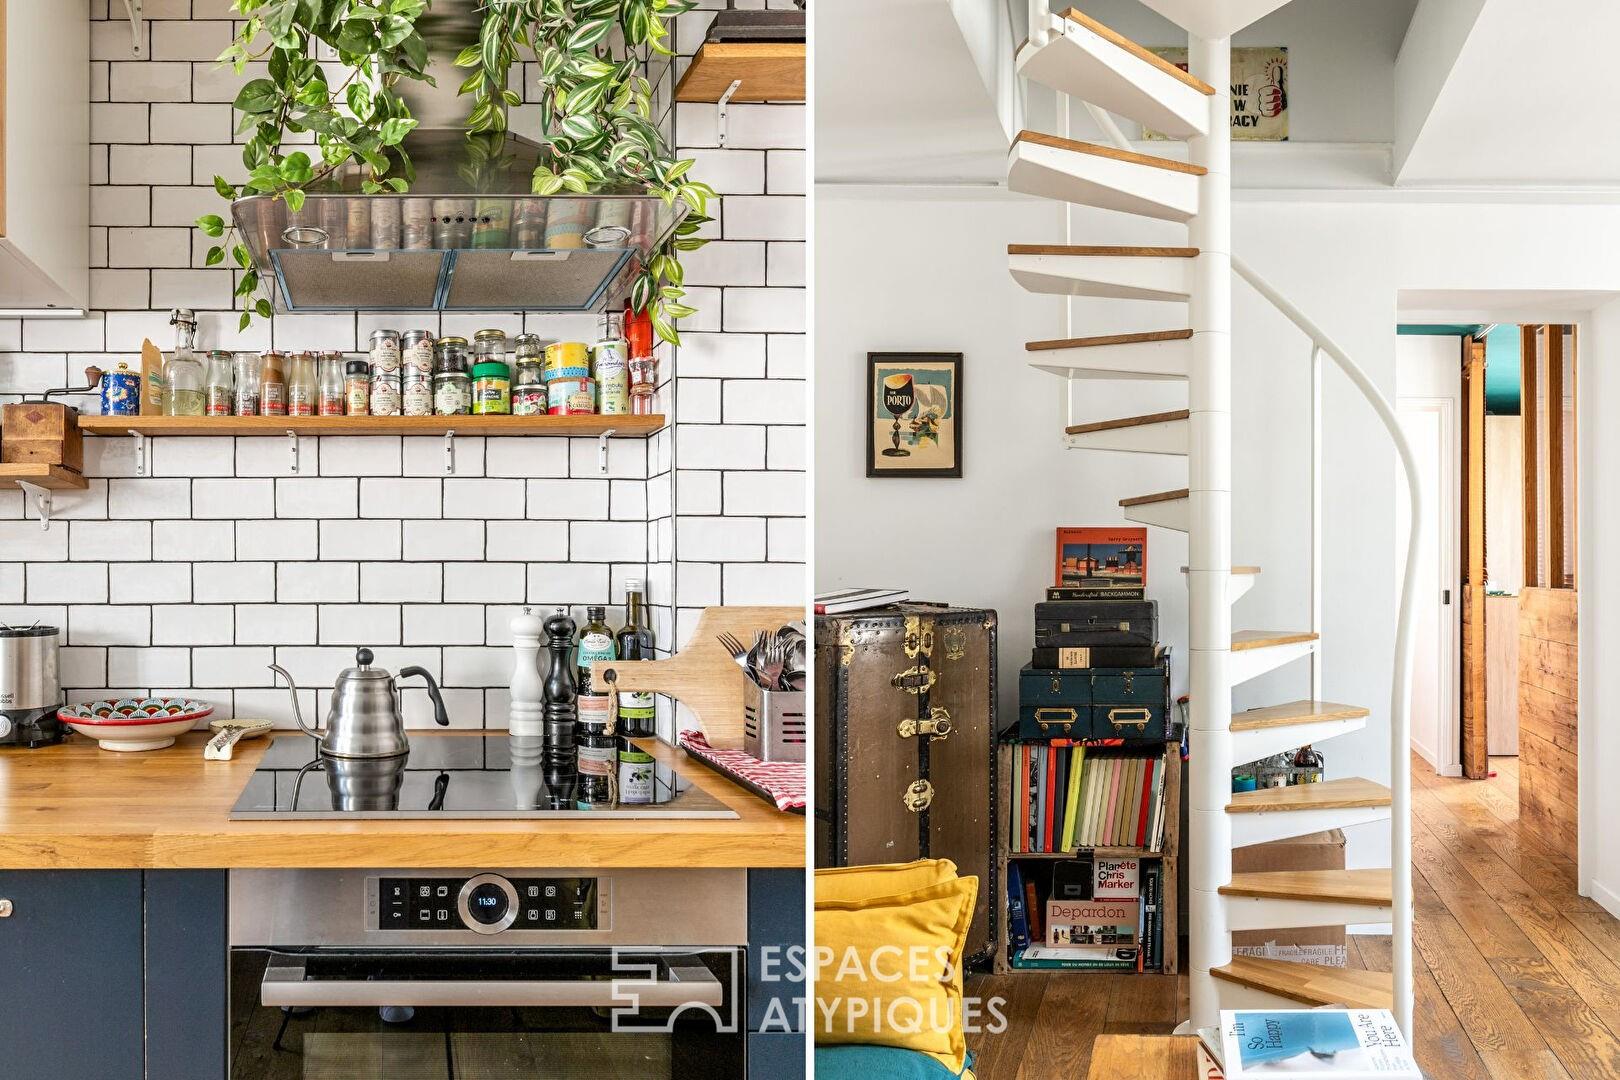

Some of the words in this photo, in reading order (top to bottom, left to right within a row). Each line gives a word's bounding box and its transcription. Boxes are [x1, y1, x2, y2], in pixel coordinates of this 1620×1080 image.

[1230, 115, 1259, 127] ACY
[887, 395, 911, 406] PORTO
[1098, 861, 1137, 871] Planète
[1098, 870, 1125, 880] Chris
[1097, 880, 1135, 889] Marker
[478, 897, 497, 906] 11:30
[1052, 905, 1126, 920] Depardon
[1265, 1018, 1283, 1049] Happy
[1364, 1029, 1382, 1048] You
[1380, 1025, 1401, 1048] Here
[1247, 1036, 1265, 1050] So
